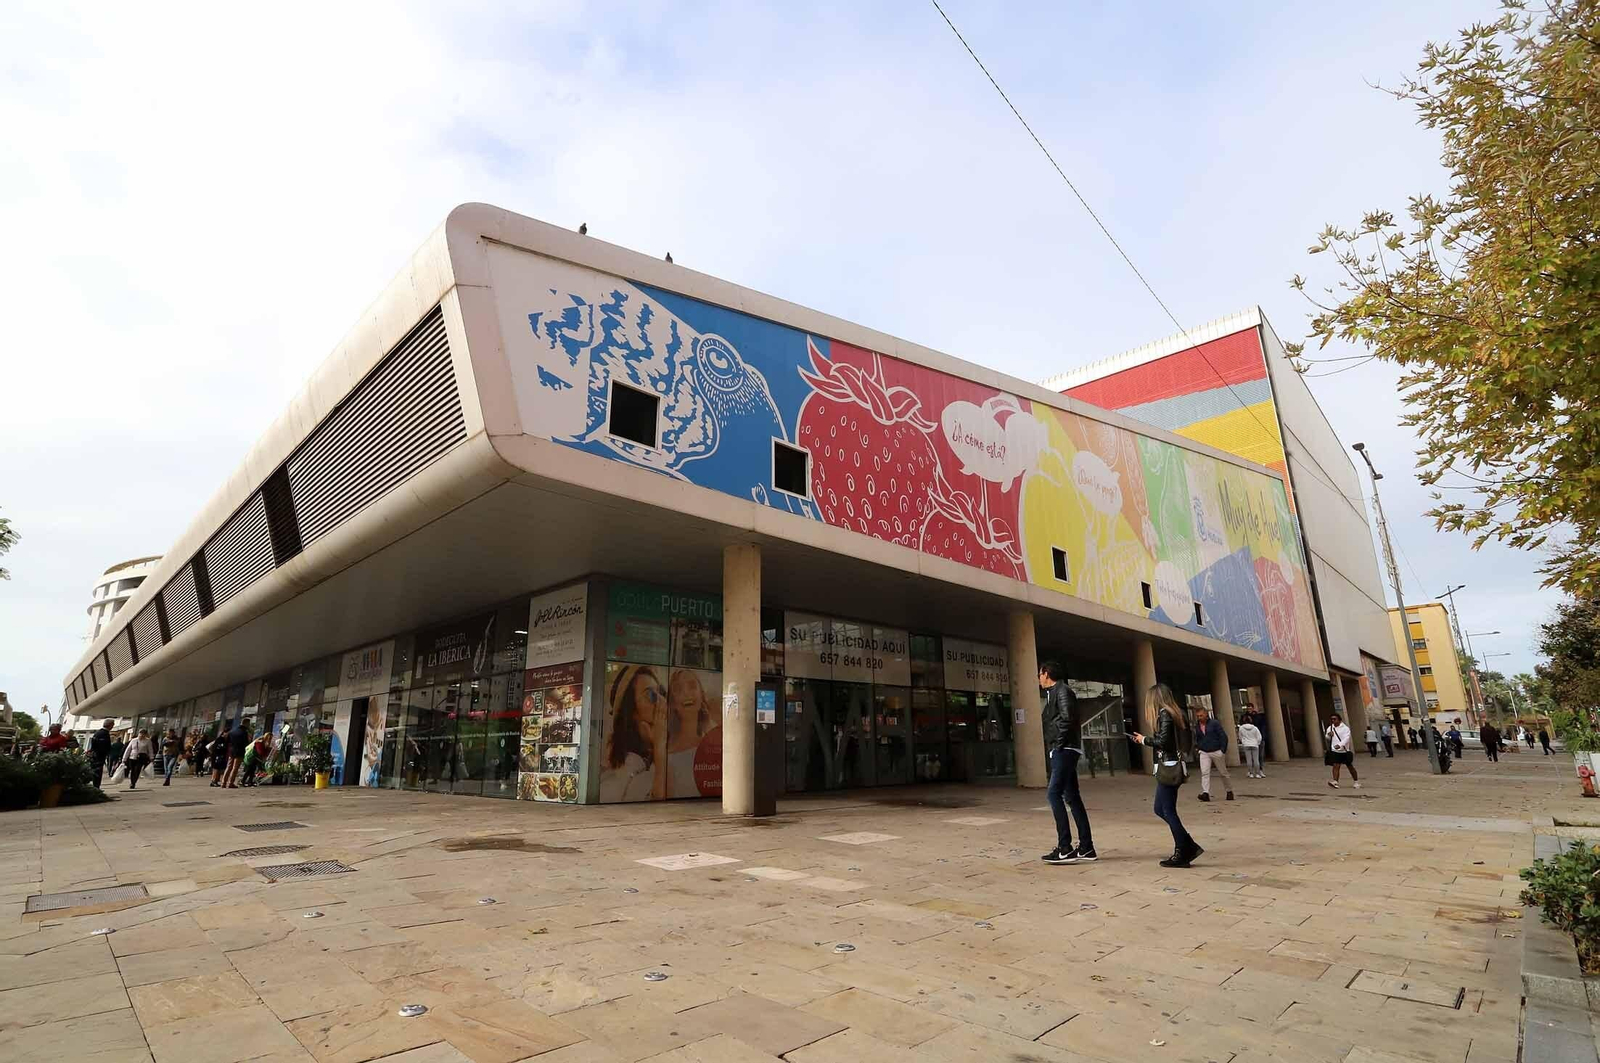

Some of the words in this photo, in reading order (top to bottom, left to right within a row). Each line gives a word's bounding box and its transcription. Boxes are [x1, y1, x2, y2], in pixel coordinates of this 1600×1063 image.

[965, 433, 984, 451] cómo
[1218, 479, 1250, 547] Muy
[1246, 490, 1261, 541] de
[661, 594, 714, 618] PUERTO
[790, 628, 807, 641] SU
[812, 630, 879, 651] PUBLICIDAD
[882, 640, 906, 655] AQUÍ
[427, 653, 437, 667] LA
[439, 645, 471, 665] IBÉRICA
[820, 652, 839, 665] 657
[843, 655, 862, 667] 844
[866, 657, 883, 669] 820
[946, 650, 958, 661] SU
[960, 652, 1004, 668] PUBLICIDAD
[966, 669, 979, 681] 657
[703, 780, 722, 788] Fashi
